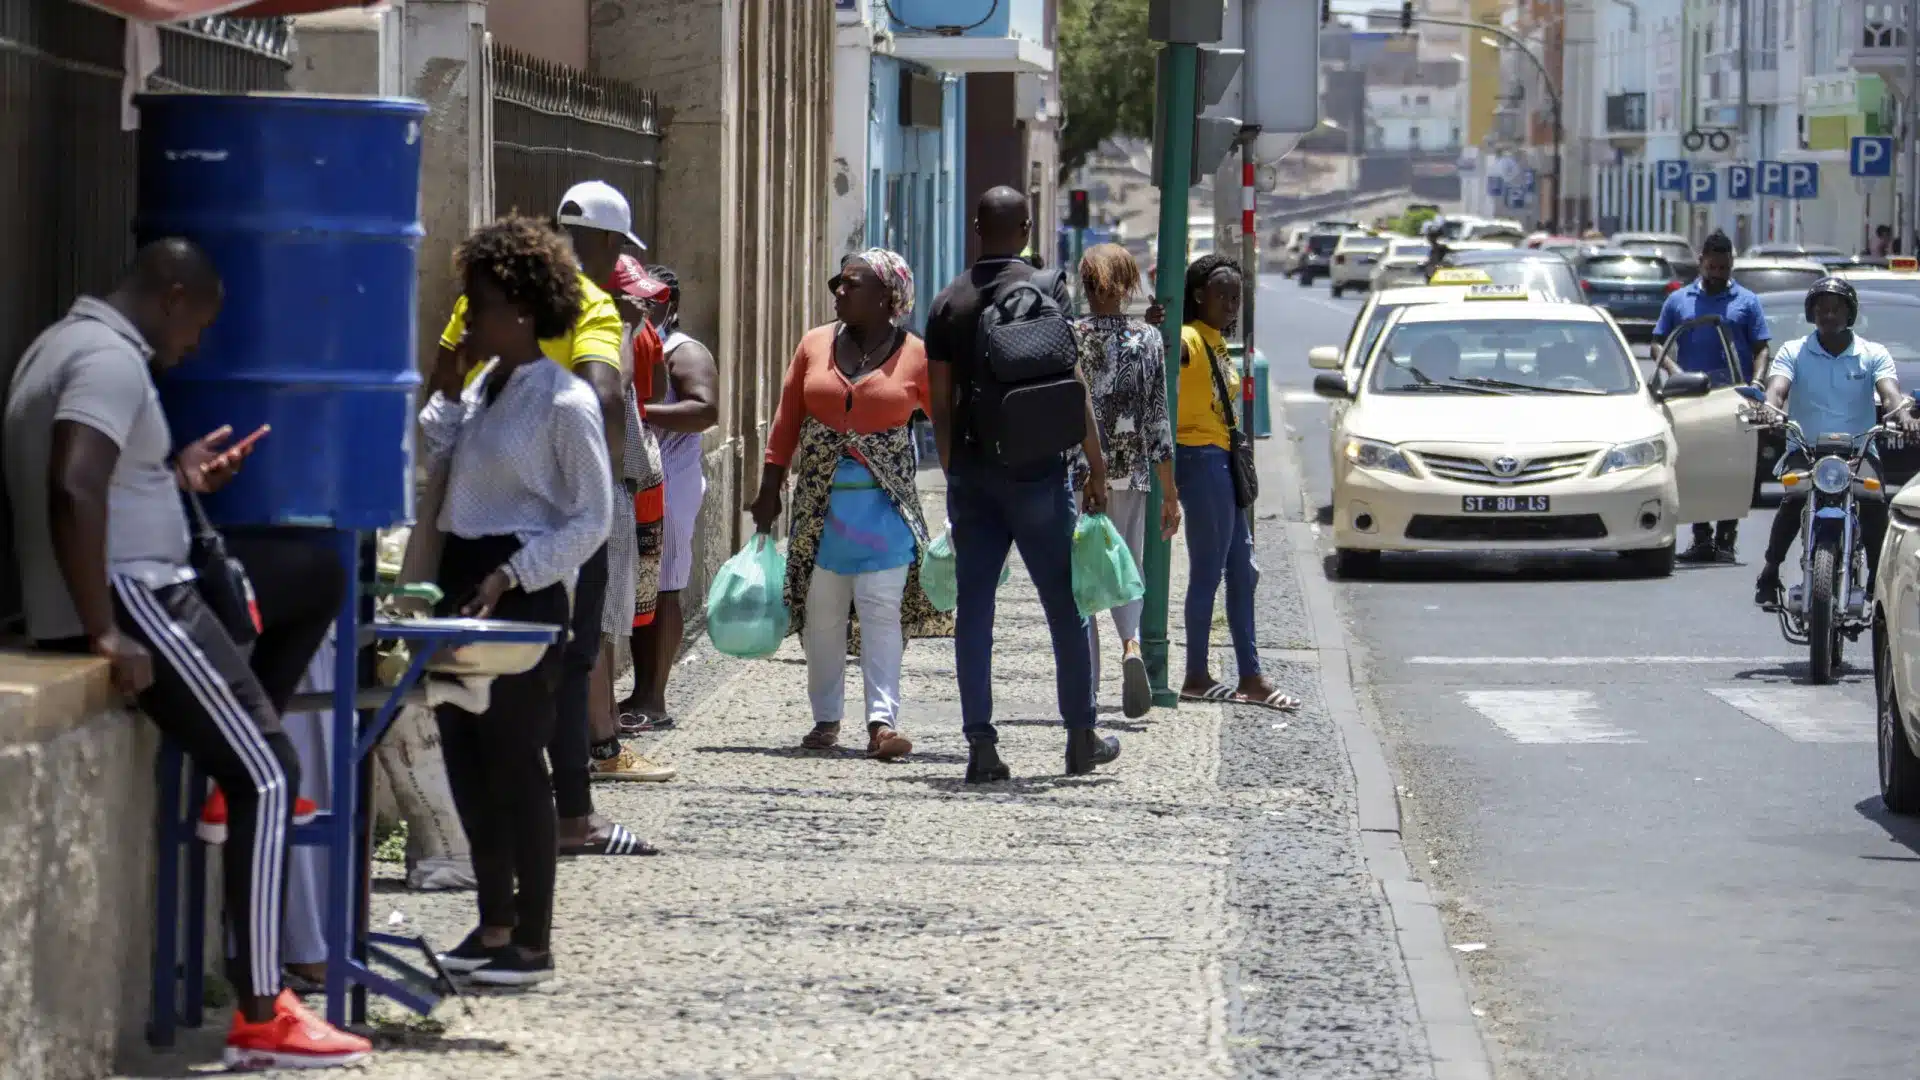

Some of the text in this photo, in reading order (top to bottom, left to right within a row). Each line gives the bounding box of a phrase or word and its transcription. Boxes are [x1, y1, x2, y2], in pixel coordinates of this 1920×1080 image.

[1859, 139, 1884, 174] P
[1662, 163, 1682, 189] P
[1690, 174, 1711, 201] P
[1732, 168, 1747, 196] P
[1763, 163, 1784, 193] P
[1788, 166, 1811, 196] P
[1465, 496, 1547, 511] ST 80 LS
